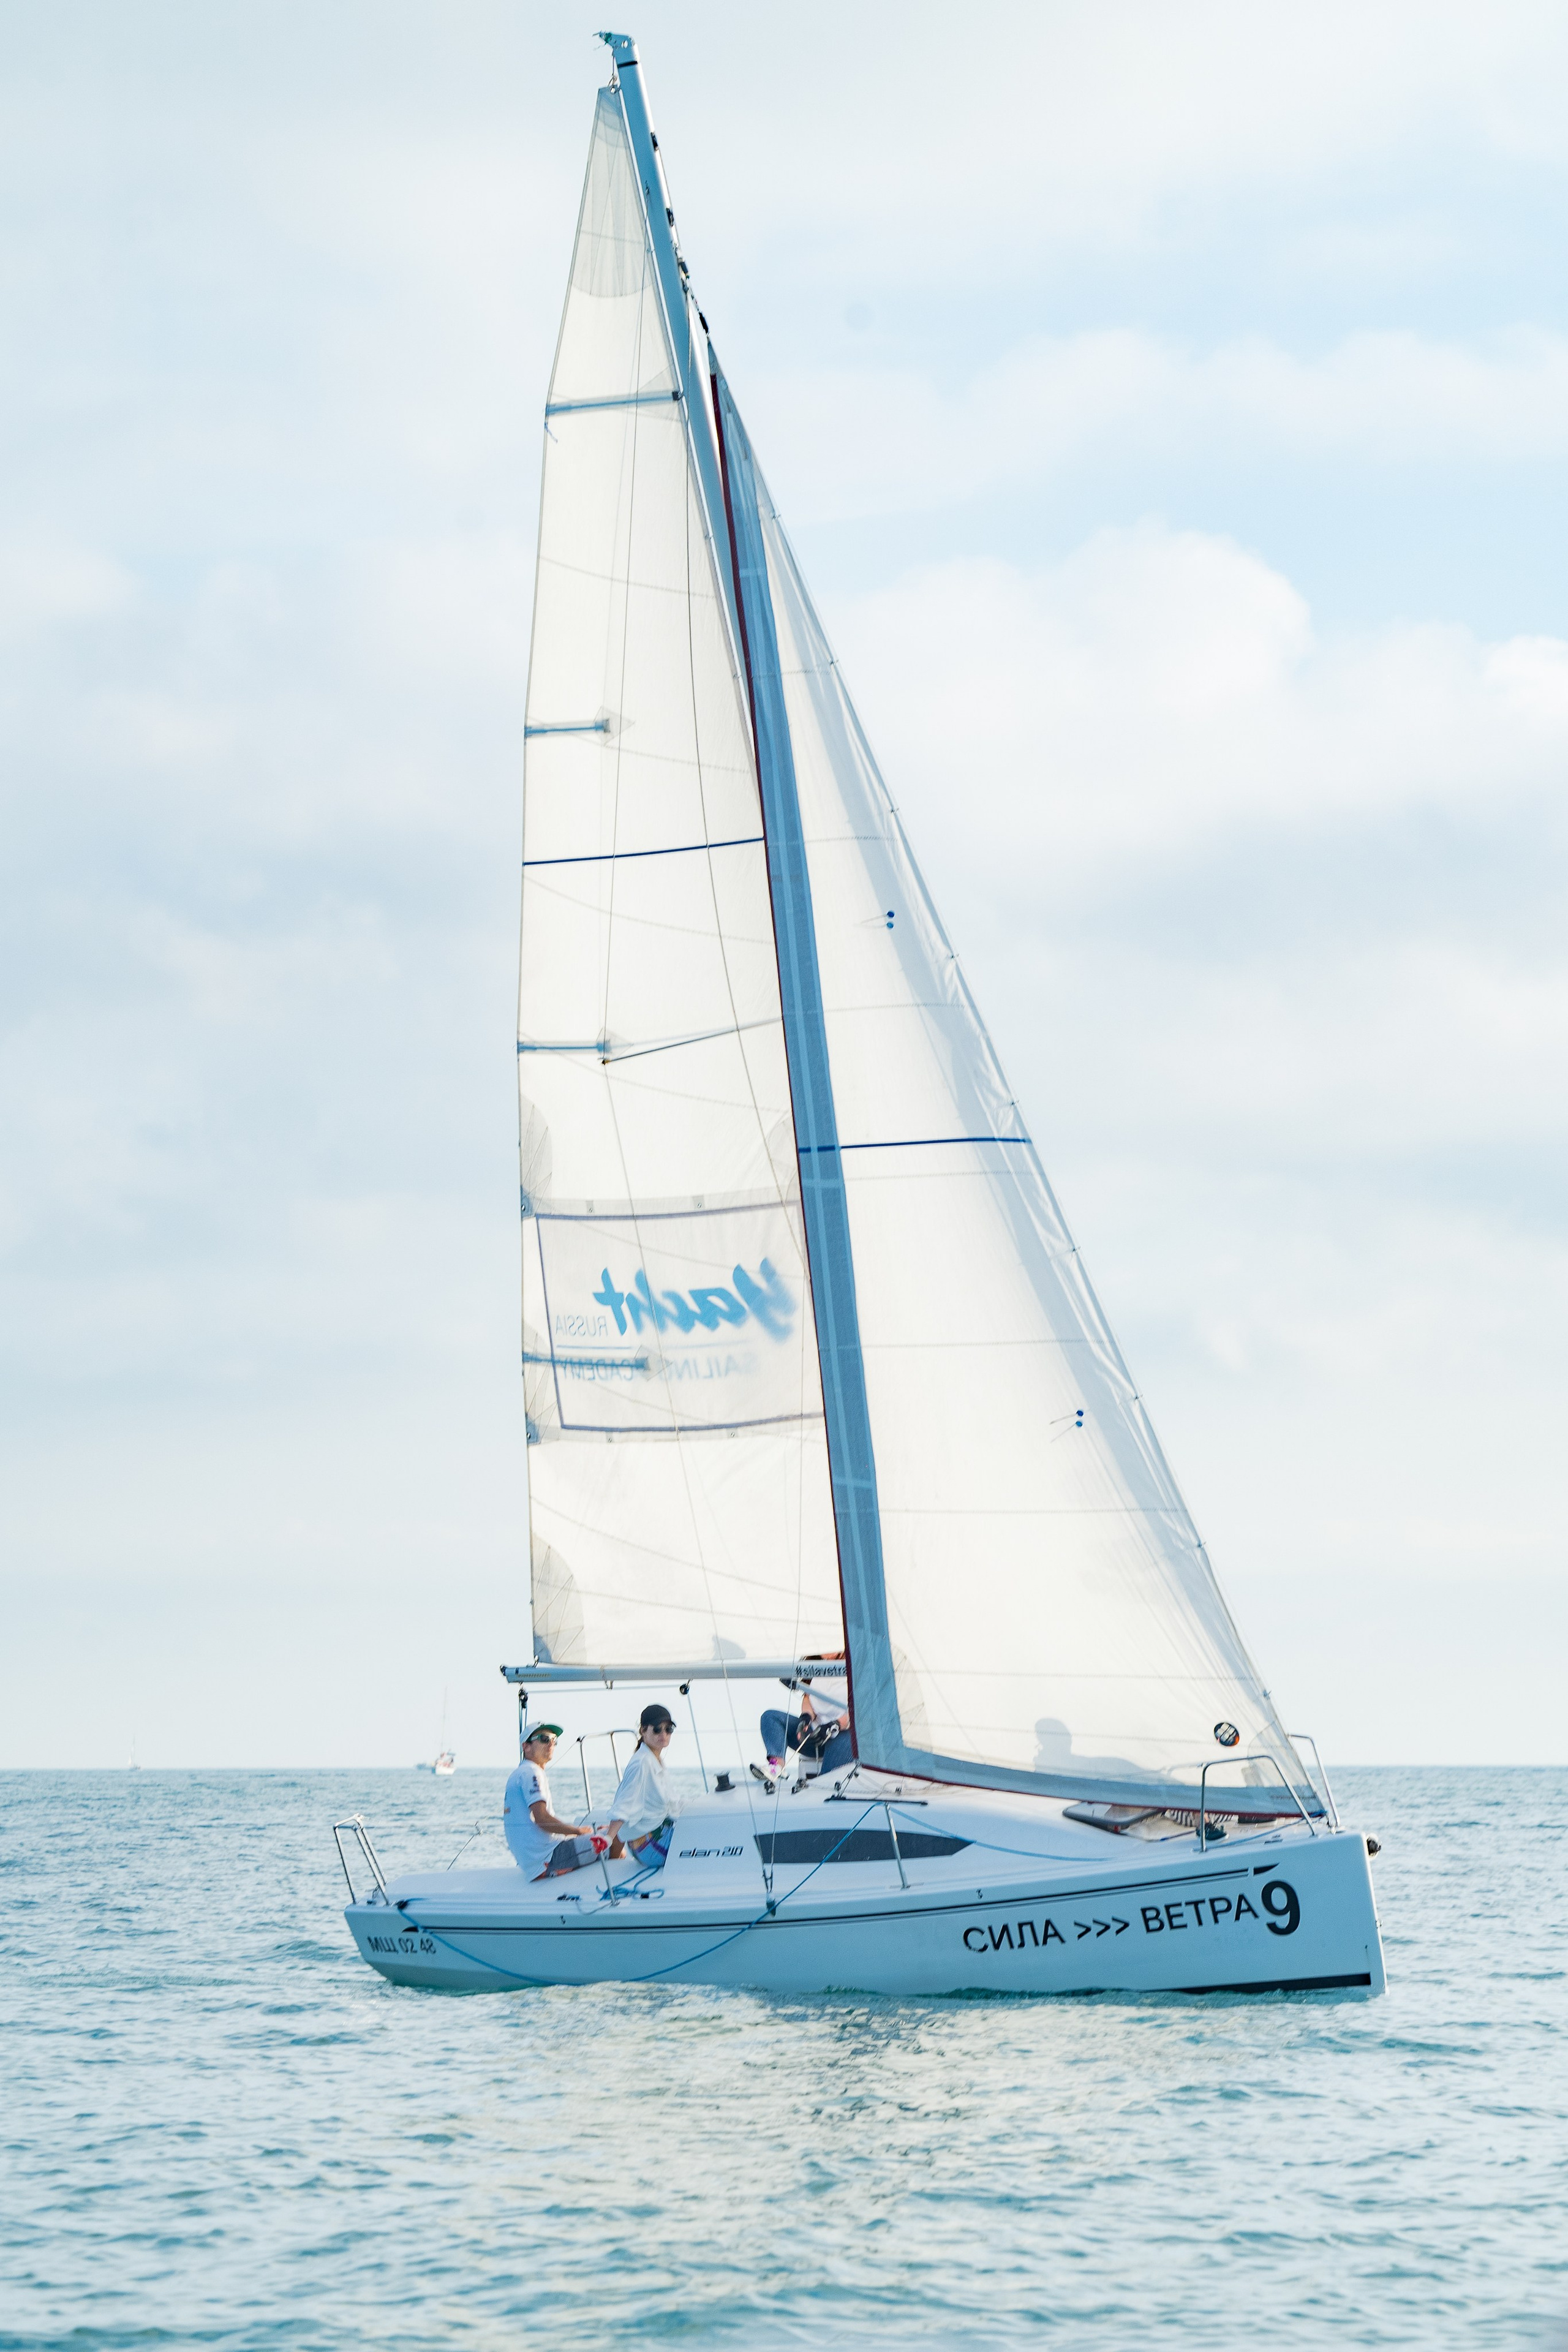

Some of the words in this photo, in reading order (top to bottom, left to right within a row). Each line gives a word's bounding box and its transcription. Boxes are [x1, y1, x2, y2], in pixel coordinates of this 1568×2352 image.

[679, 1847, 720, 1859] elan
[962, 1918, 1066, 1953] СИЛА
[1140, 1893, 1259, 1934] ВЕТРА
[1261, 1880, 1301, 1936] 9
